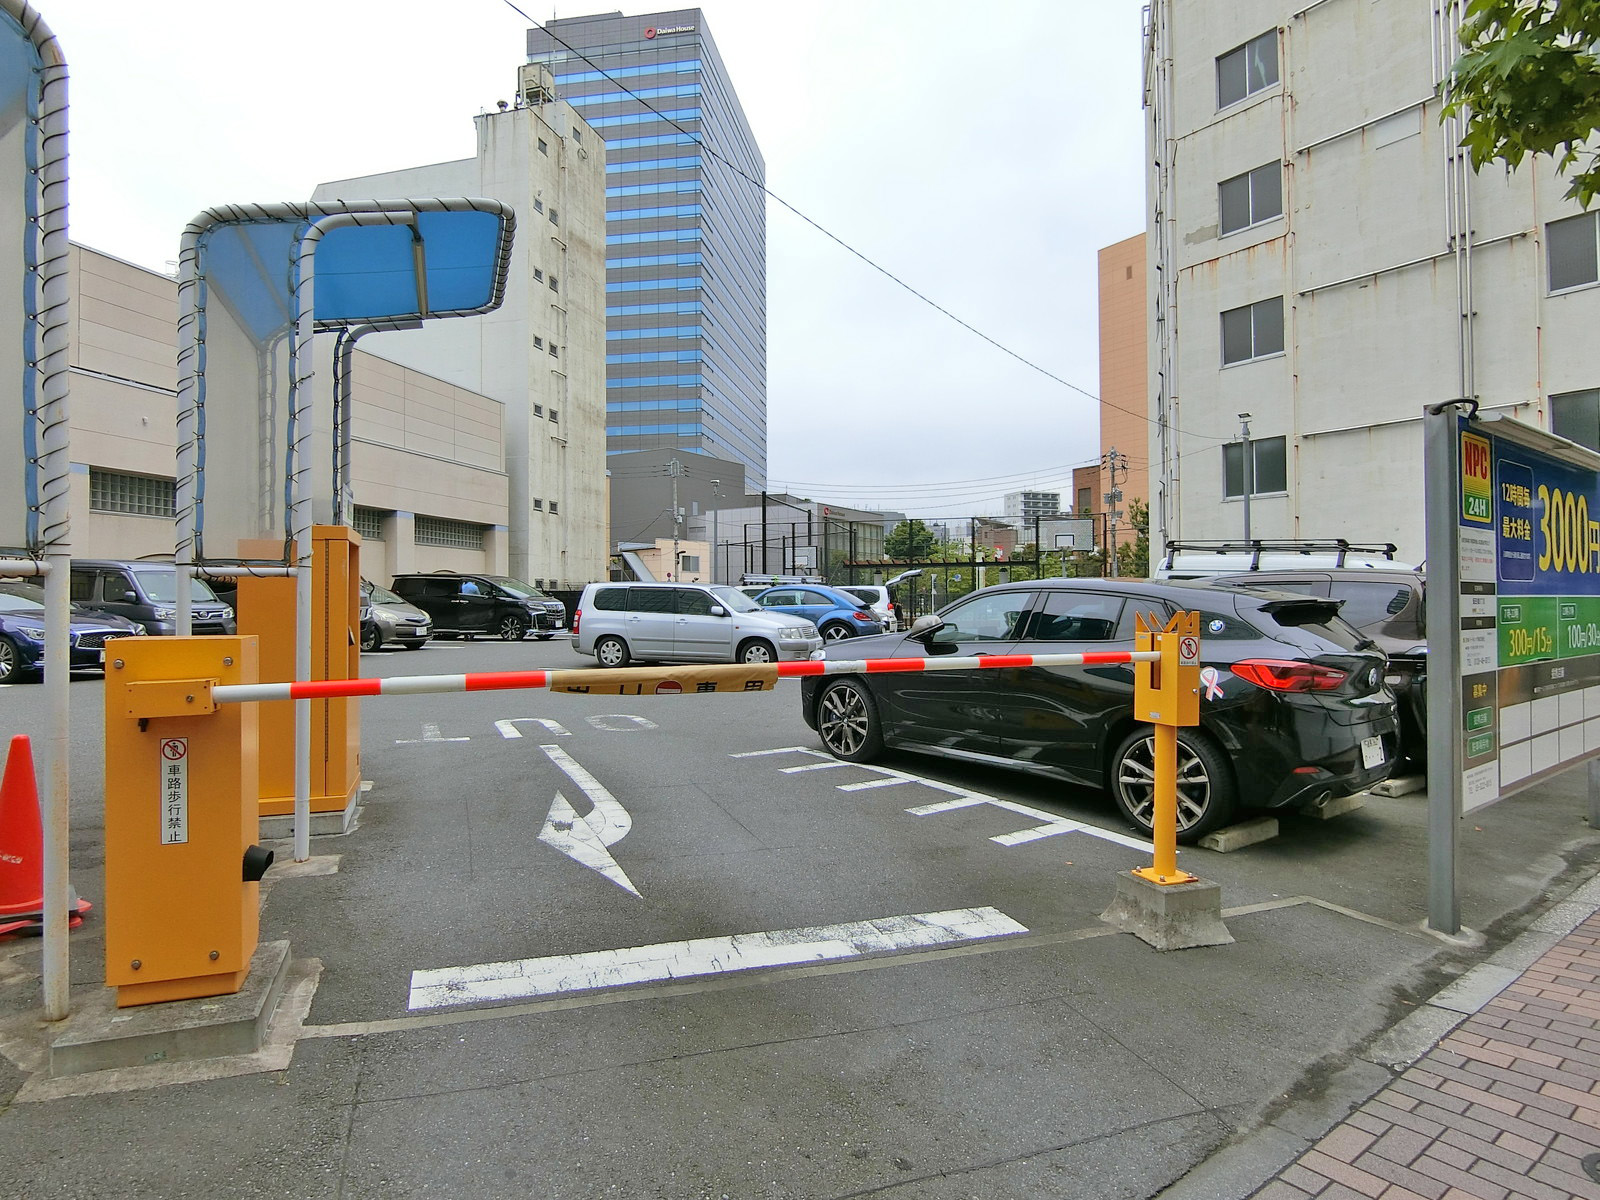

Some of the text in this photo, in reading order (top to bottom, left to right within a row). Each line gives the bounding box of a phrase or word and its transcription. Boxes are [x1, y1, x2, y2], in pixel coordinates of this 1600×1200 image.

[657, 27, 676, 35] Daiwa
[1465, 440, 1488, 480] NPC
[1468, 497, 1486, 517] 24H
[1503, 516, 1531, 541] 最大料金
[1538, 484, 1600, 573] 3000円
[168, 764, 182, 843] 車路歩行禁止
